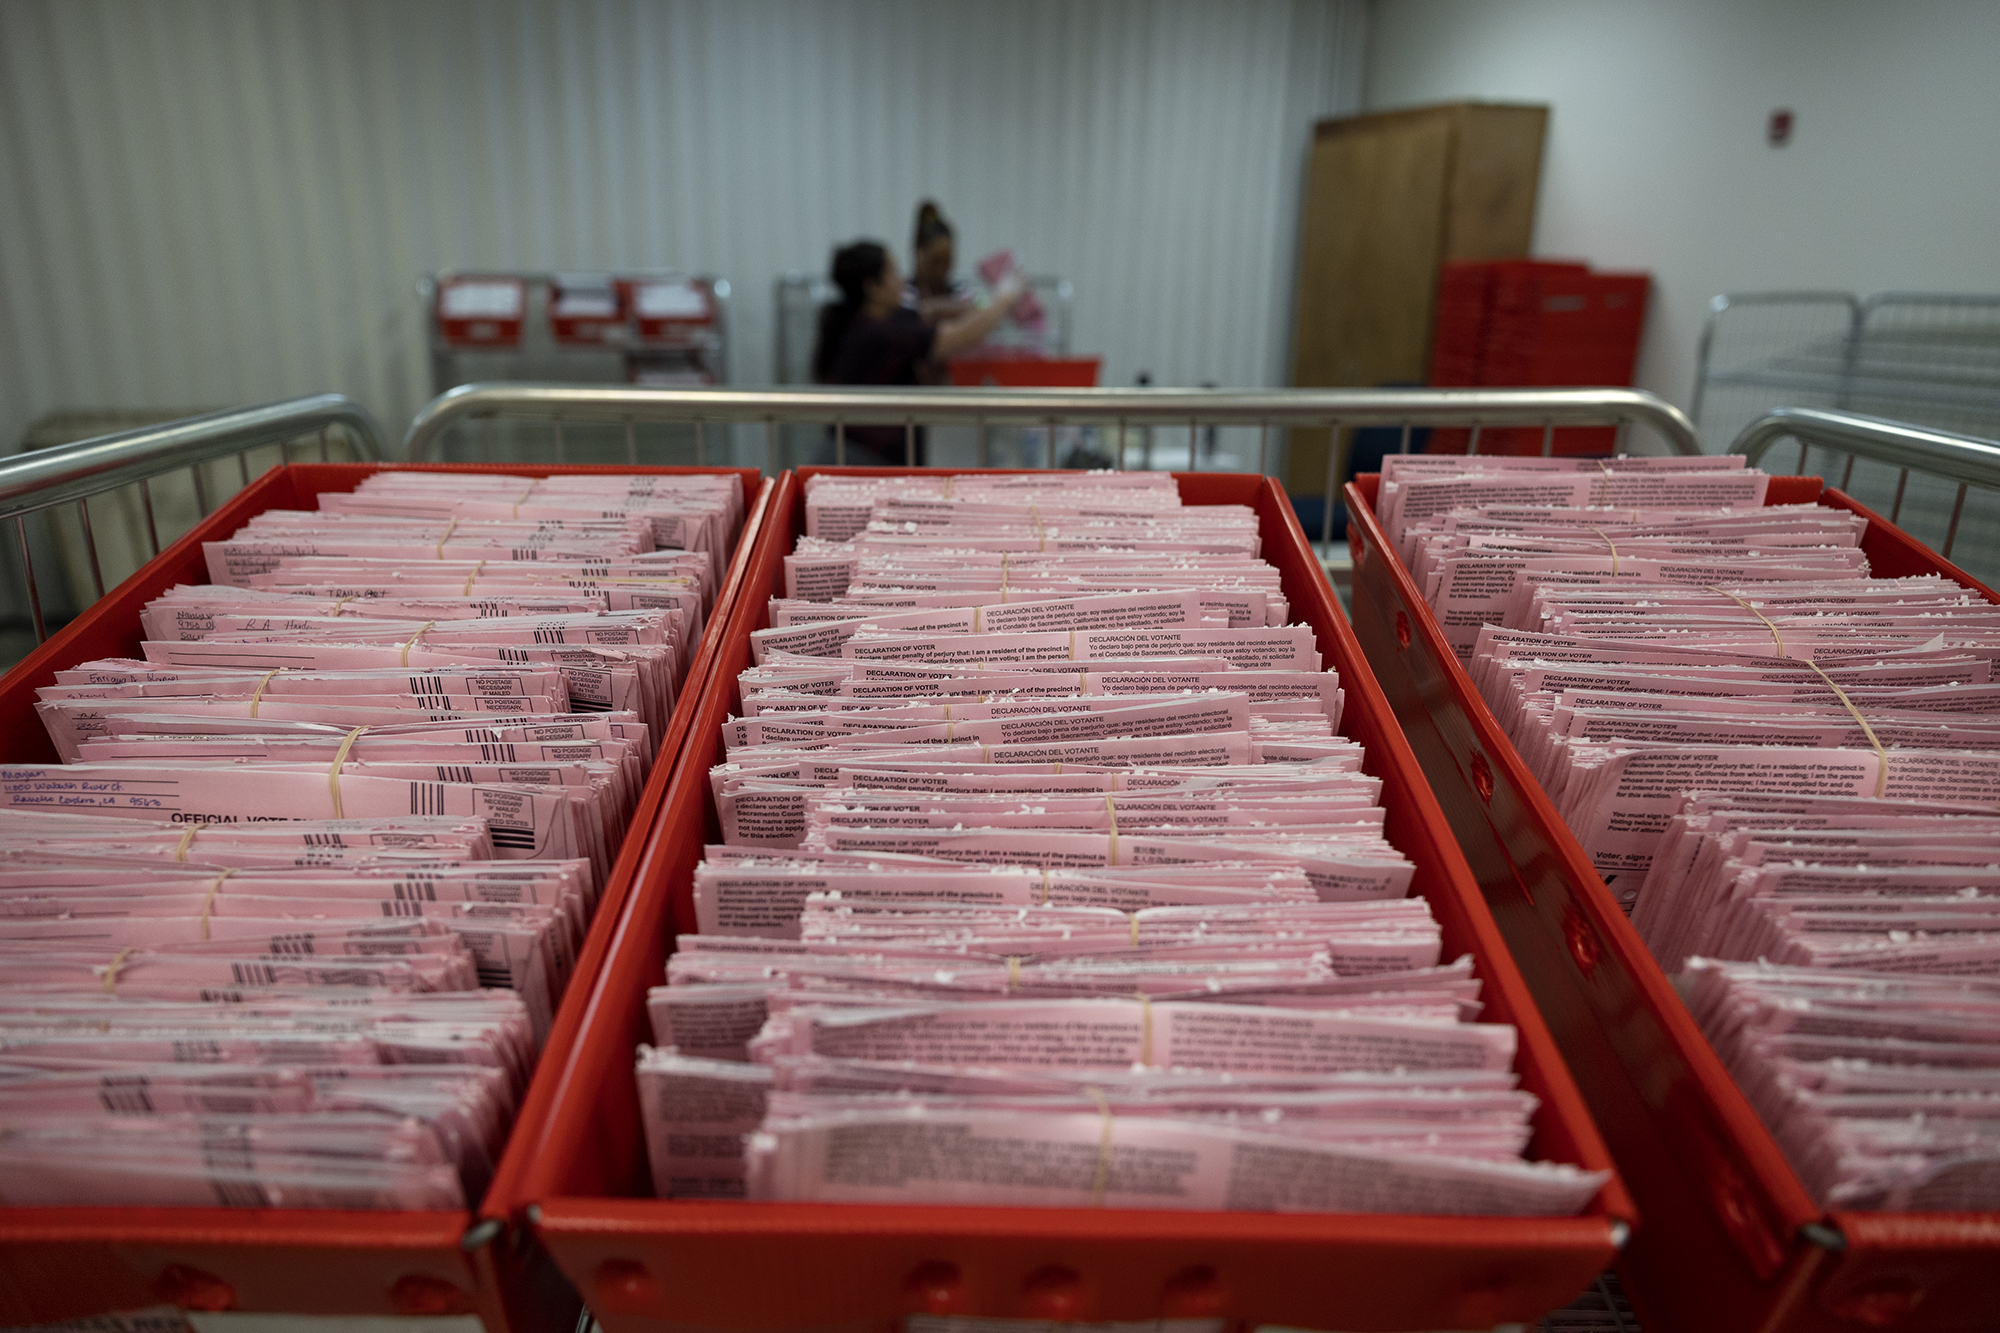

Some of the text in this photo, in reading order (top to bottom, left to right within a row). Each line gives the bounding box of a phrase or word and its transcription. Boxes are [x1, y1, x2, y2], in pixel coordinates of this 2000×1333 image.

[1660, 566, 1702, 574] DECLARACIÓN
[987, 607, 1031, 617] DECLARACIÓN
[1046, 604, 1074, 612] VOTANTE
[762, 635, 807, 646] DECLARATION
[1089, 635, 1135, 643] DECLARACIÓN
[855, 646, 899, 654] DECLARATION
[1510, 650, 1557, 658] DECLARATION
[902, 652, 924, 660] penalty
[934, 650, 956, 658] perjury
[866, 670, 916, 678] DECLARATION
[570, 676, 602, 684] NECESSARY
[1102, 676, 1150, 684] DECLARACIÓN
[1544, 674, 1594, 684] DECLARATION
[853, 686, 902, 694] DECLARATION
[1576, 698, 1626, 708] DECLARATION
[1638, 702, 1662, 710] VOTER
[991, 705, 1041, 714] DECLARACIÓN
[1201, 708, 1228, 718] electoral
[1001, 720, 1053, 730] DECLARACIÓN
[1070, 716, 1104, 724] VOTANTE
[1587, 720, 1639, 728] DECLARATION
[762, 726, 812, 736] DECLARATION
[994, 747, 1100, 758] DECLARACIÓN DEL VOTANTE
[853, 774, 908, 784] DECLARATION
[494, 792, 523, 801] POSTAGE
[484, 798, 522, 807] NECESSARY
[171, 812, 238, 824] OFFICIAL
[738, 810, 780, 818] Sacramento
[784, 825, 805, 833] apply
[1596, 852, 1646, 862] Voter, sign
